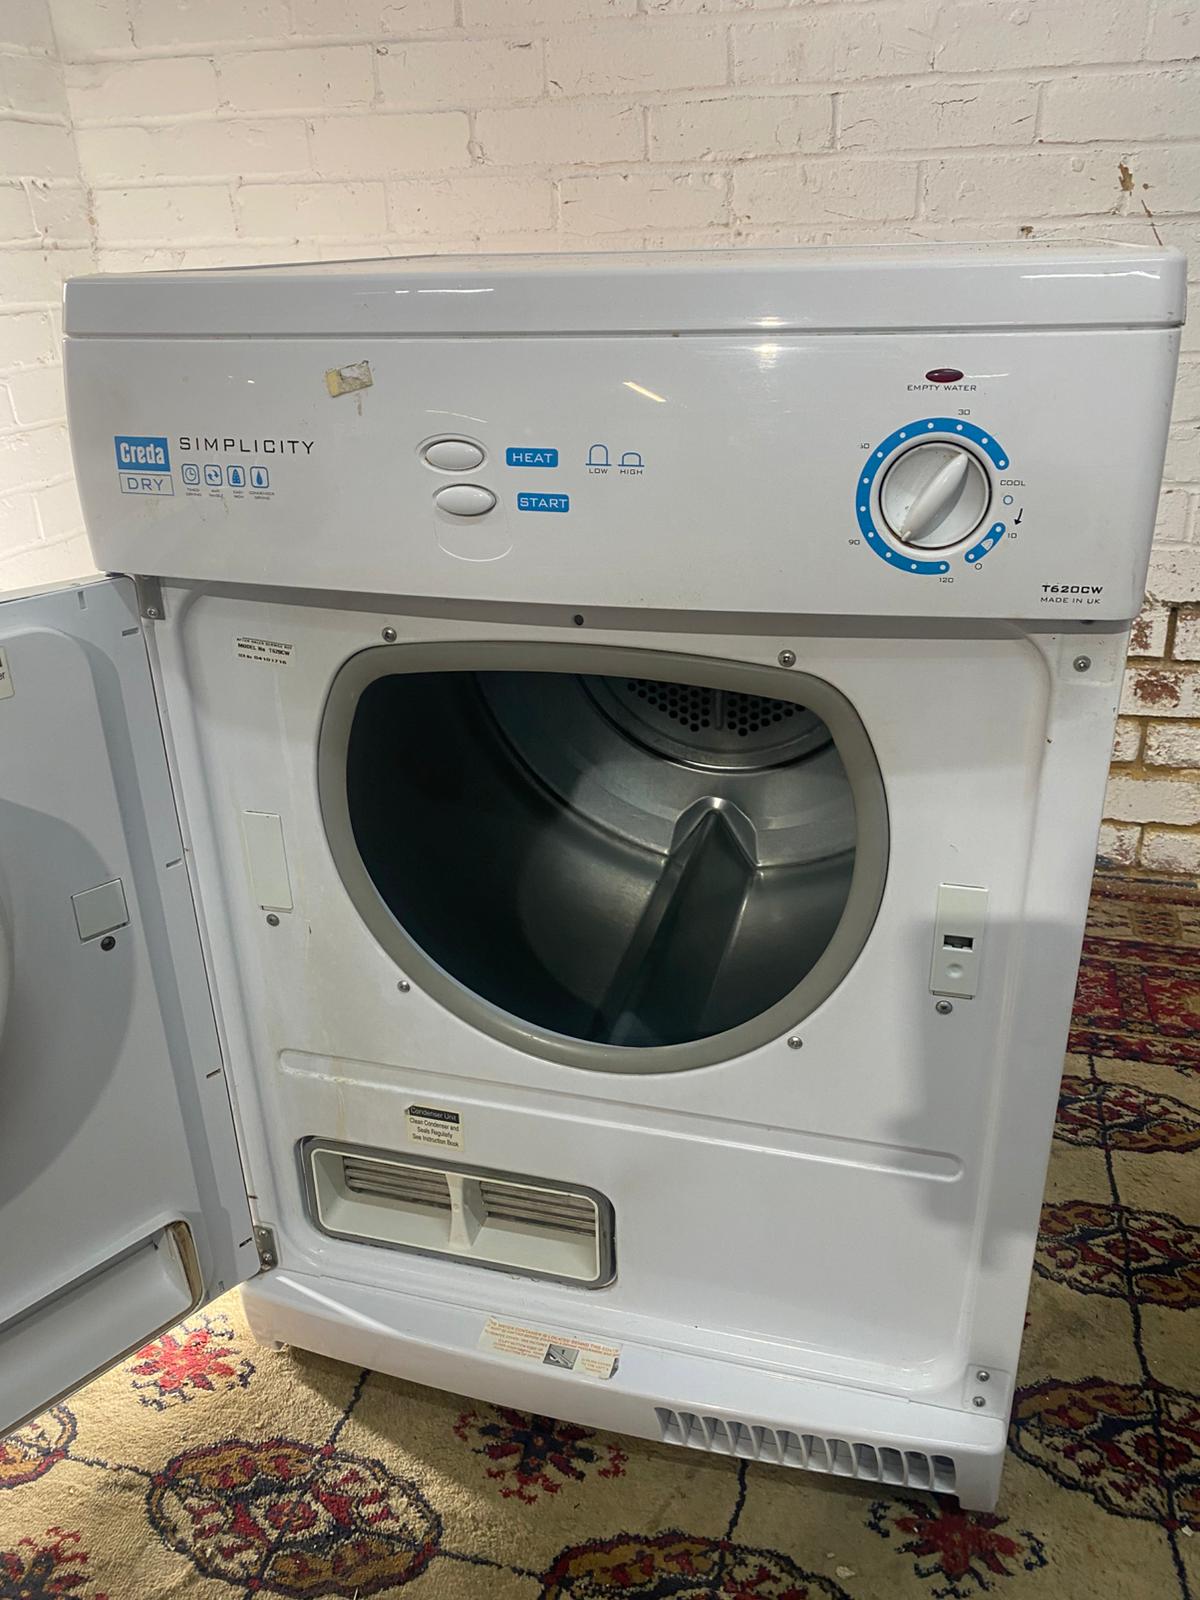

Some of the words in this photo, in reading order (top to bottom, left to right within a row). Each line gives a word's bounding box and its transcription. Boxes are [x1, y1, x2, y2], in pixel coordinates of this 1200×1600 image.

[179, 436, 314, 454] SIMPLICITY
[120, 442, 166, 464] Creda
[512, 452, 553, 464] HEAT
[127, 477, 164, 492] DRY
[520, 498, 568, 509] START
[1042, 584, 1104, 594] T620CW
[411, 1106, 444, 1118] Condenser
[444, 1112, 457, 1121] Unit
[424, 1120, 449, 1129] Condenser
[423, 1136, 446, 1144] Instruction
[447, 1139, 459, 1147] Book
